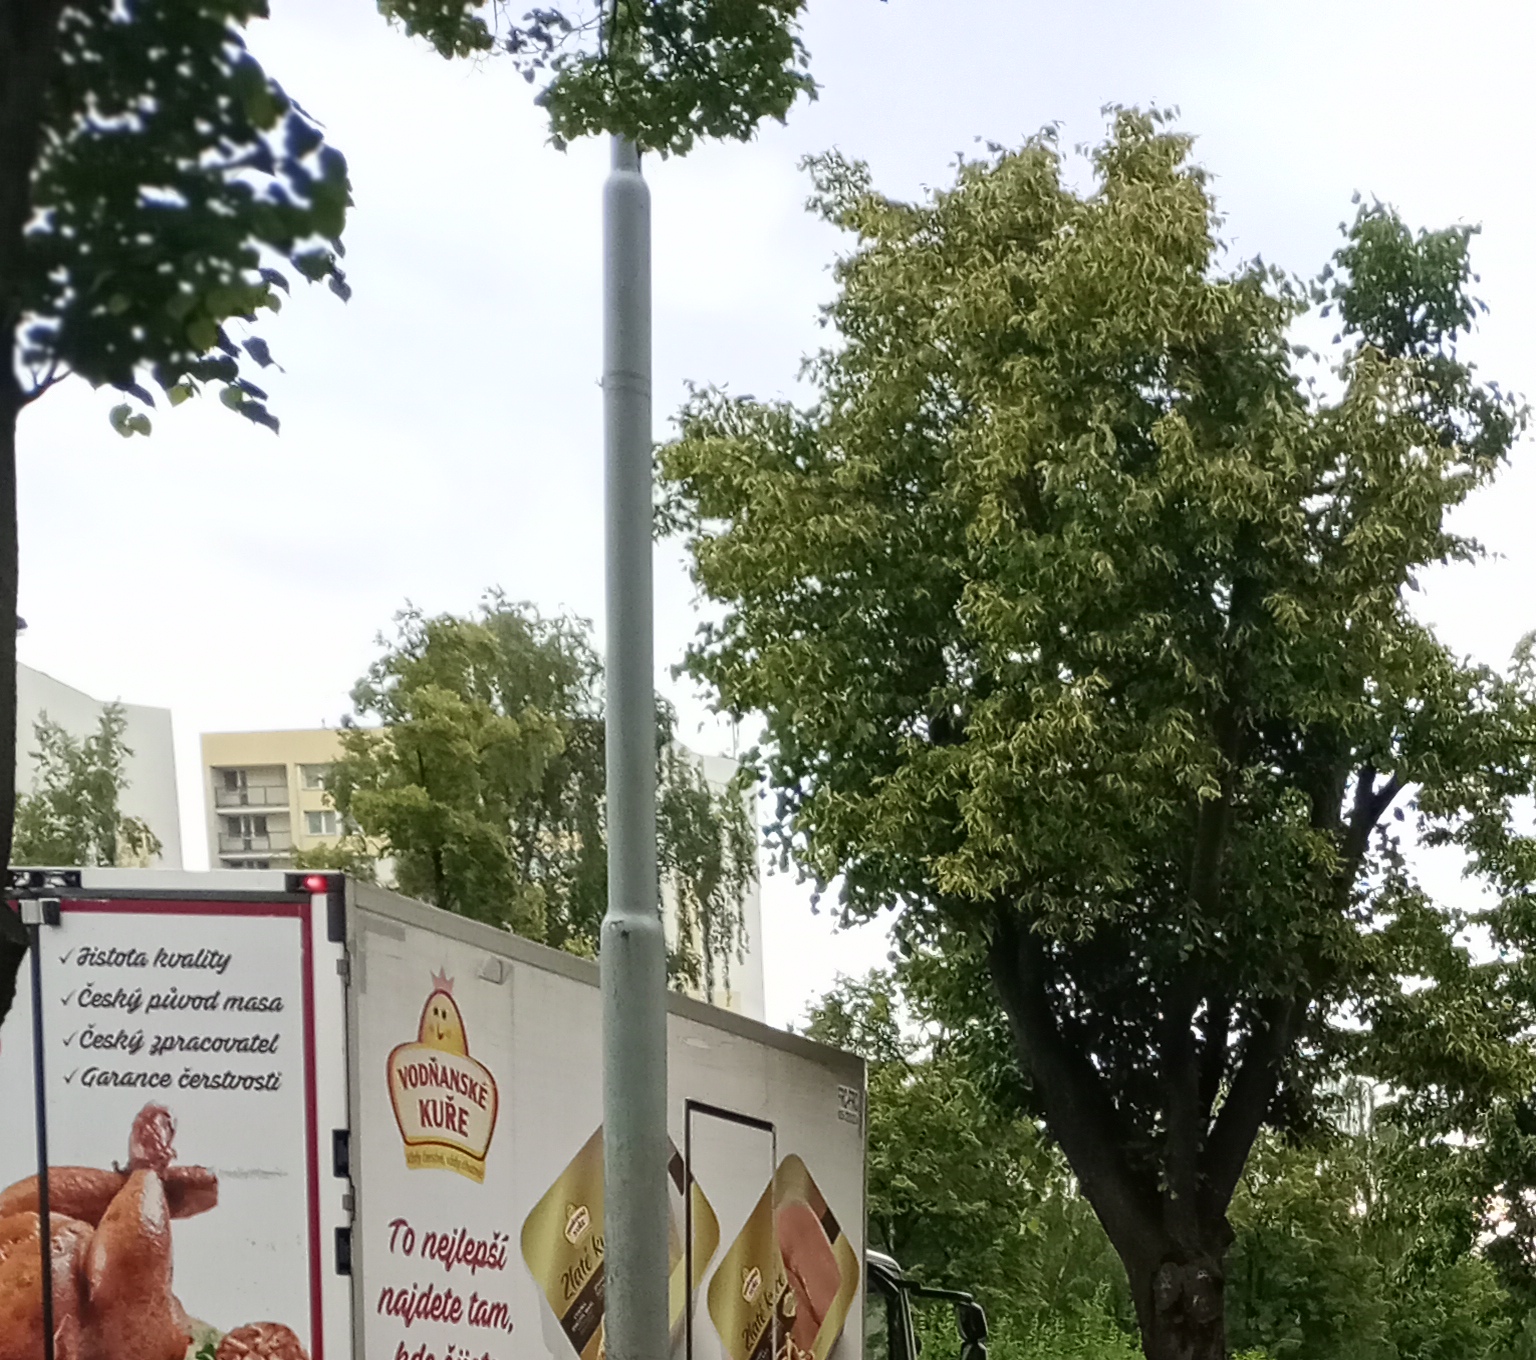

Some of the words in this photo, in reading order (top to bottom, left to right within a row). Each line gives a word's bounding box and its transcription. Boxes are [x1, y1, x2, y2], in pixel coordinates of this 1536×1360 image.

[153, 947, 232, 975] kvality
[77, 981, 143, 1014] Český
[145, 986, 220, 1014] původ
[222, 996, 284, 1013] masa
[79, 1022, 144, 1055] Český
[149, 1033, 280, 1055] zpracovatel
[80, 1066, 172, 1088] Garance
[177, 1067, 283, 1091] čerstvosti
[397, 1056, 488, 1112] VODŇANSKÉ
[418, 1094, 470, 1138] KUŘE
[388, 1218, 415, 1256] To
[421, 1226, 509, 1276] nejlepší
[377, 1282, 463, 1328] najdete
[467, 1292, 514, 1335] tam,
